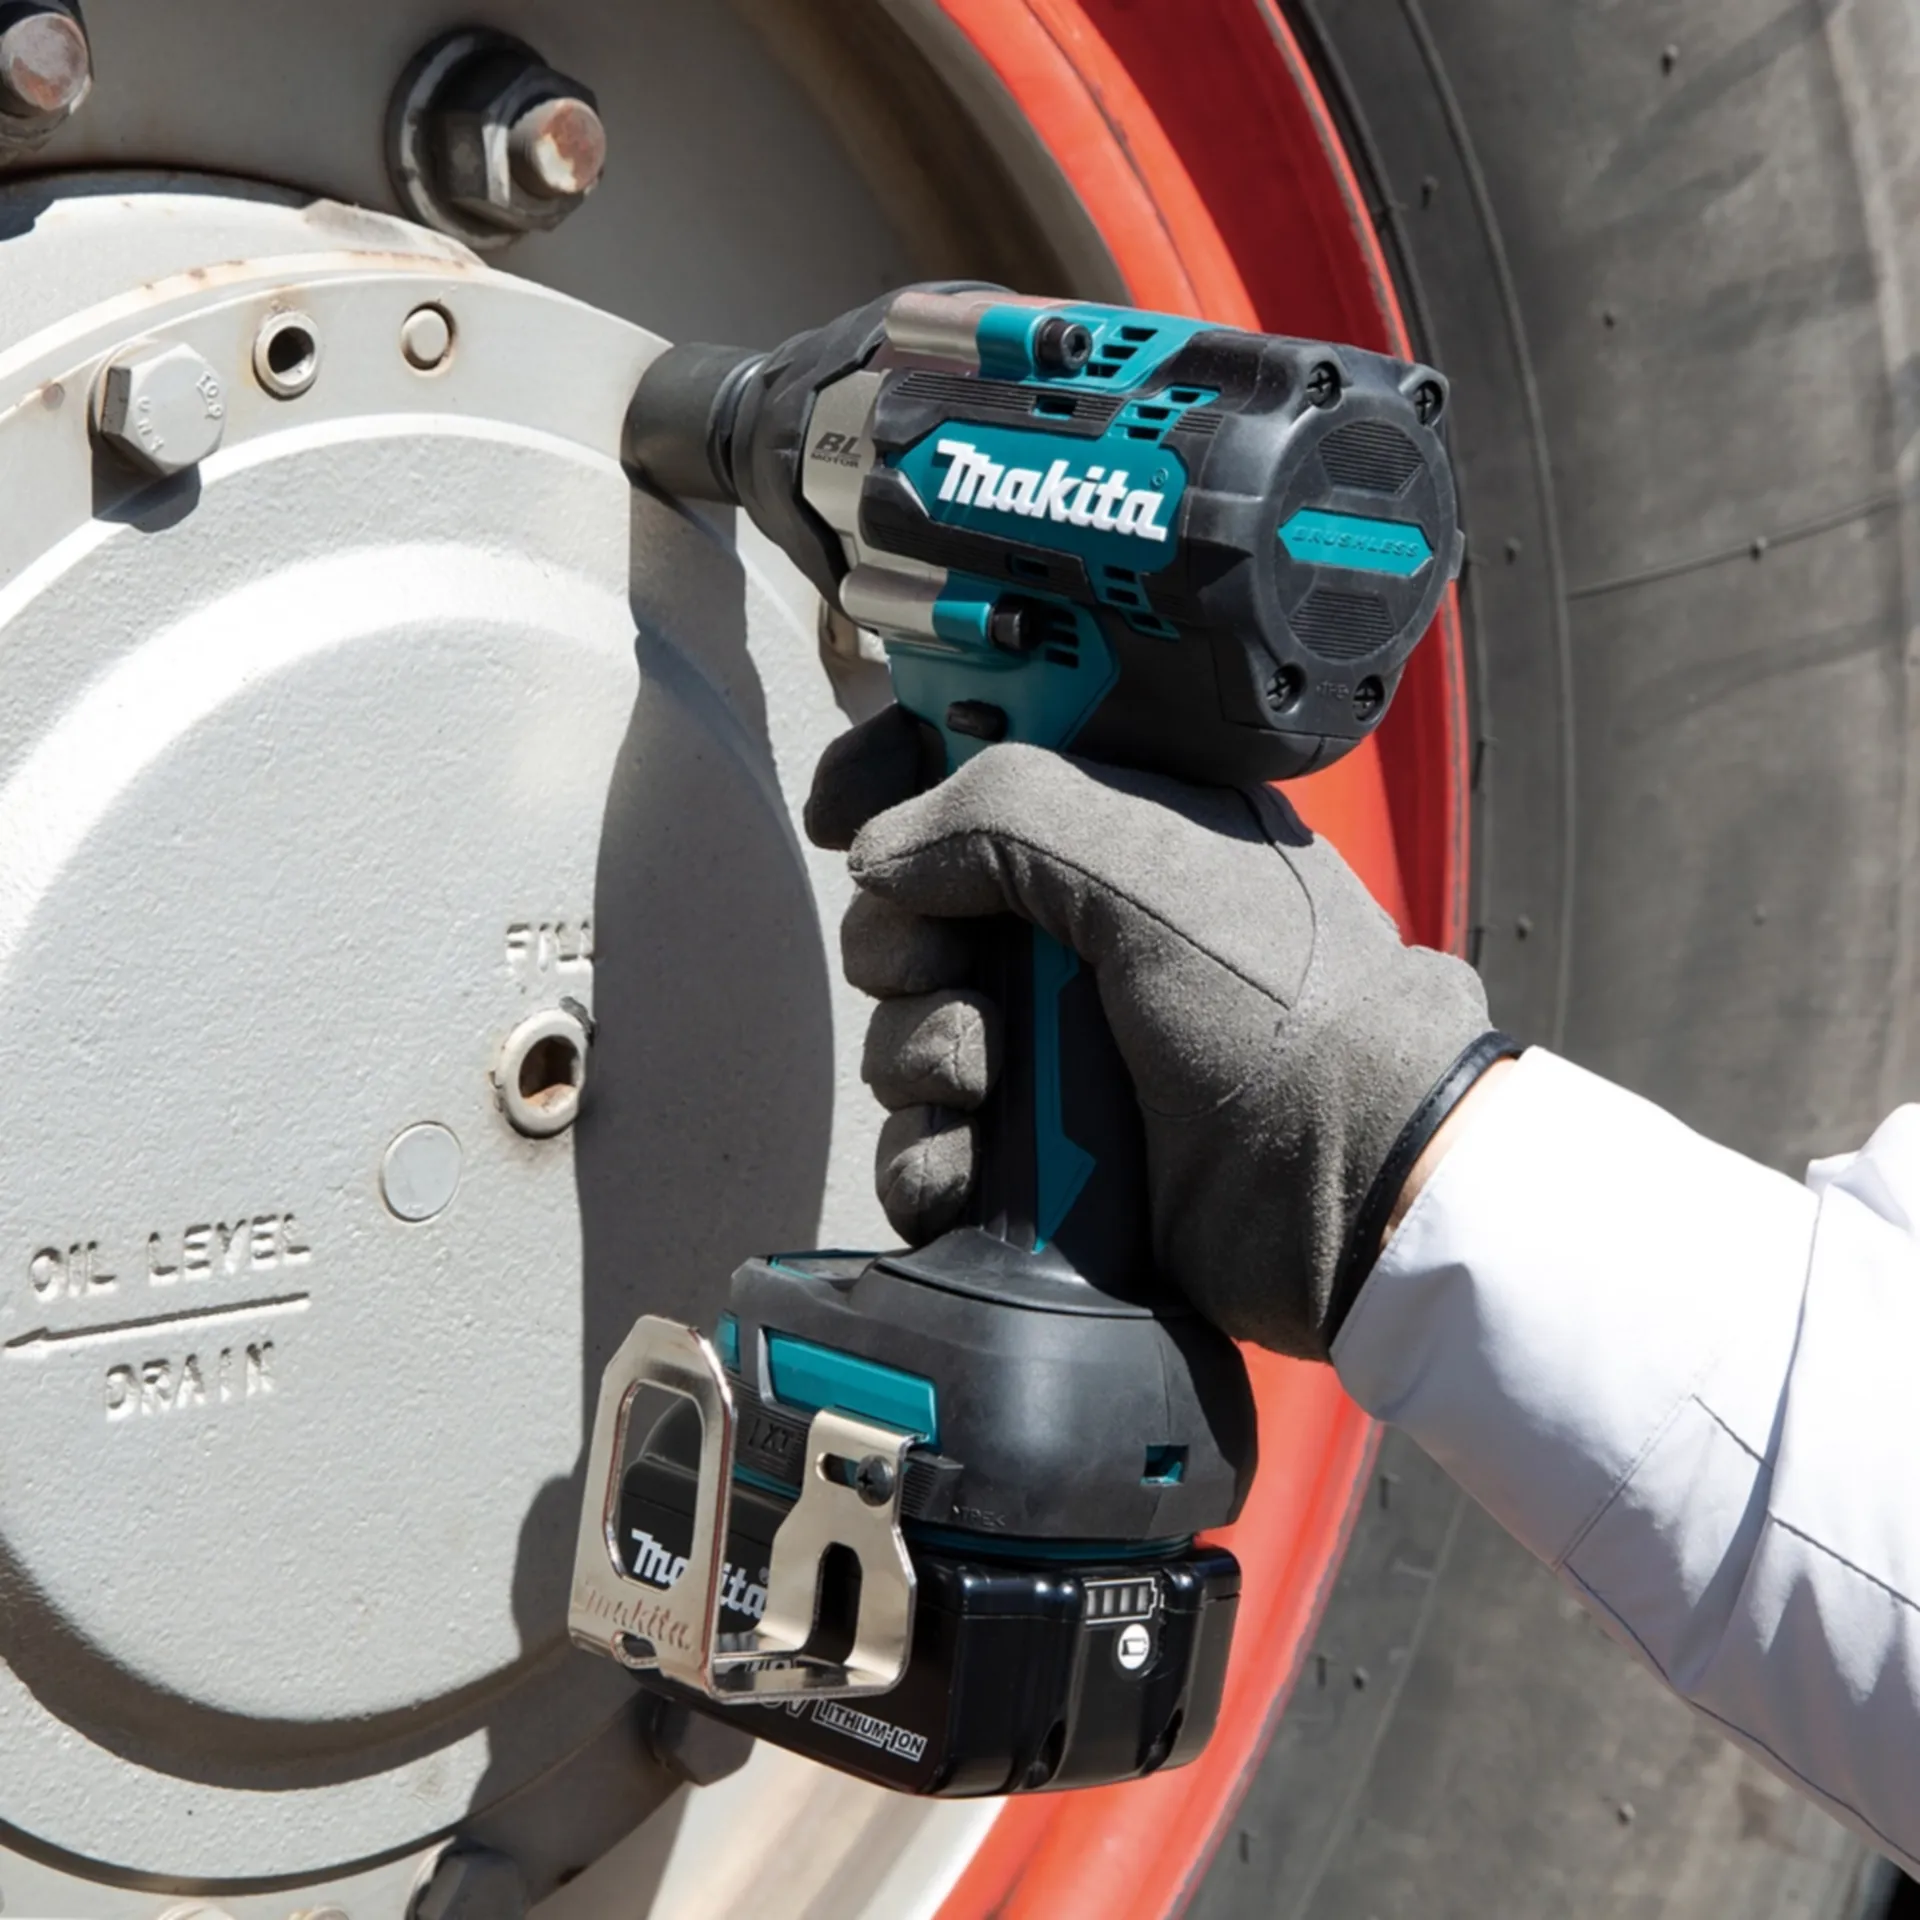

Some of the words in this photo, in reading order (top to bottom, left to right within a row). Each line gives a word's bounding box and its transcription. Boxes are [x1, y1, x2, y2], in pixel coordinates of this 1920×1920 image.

[811, 452, 859, 469] MOTOR
[815, 431, 862, 458] BL
[1292, 525, 1420, 557] BRUSHLESS
[28, 1240, 118, 1303] OIL
[147, 1212, 311, 1288] LEVEL
[105, 1340, 275, 1423] DRAIN
[812, 1698, 928, 1761] LITHIUM-ION
